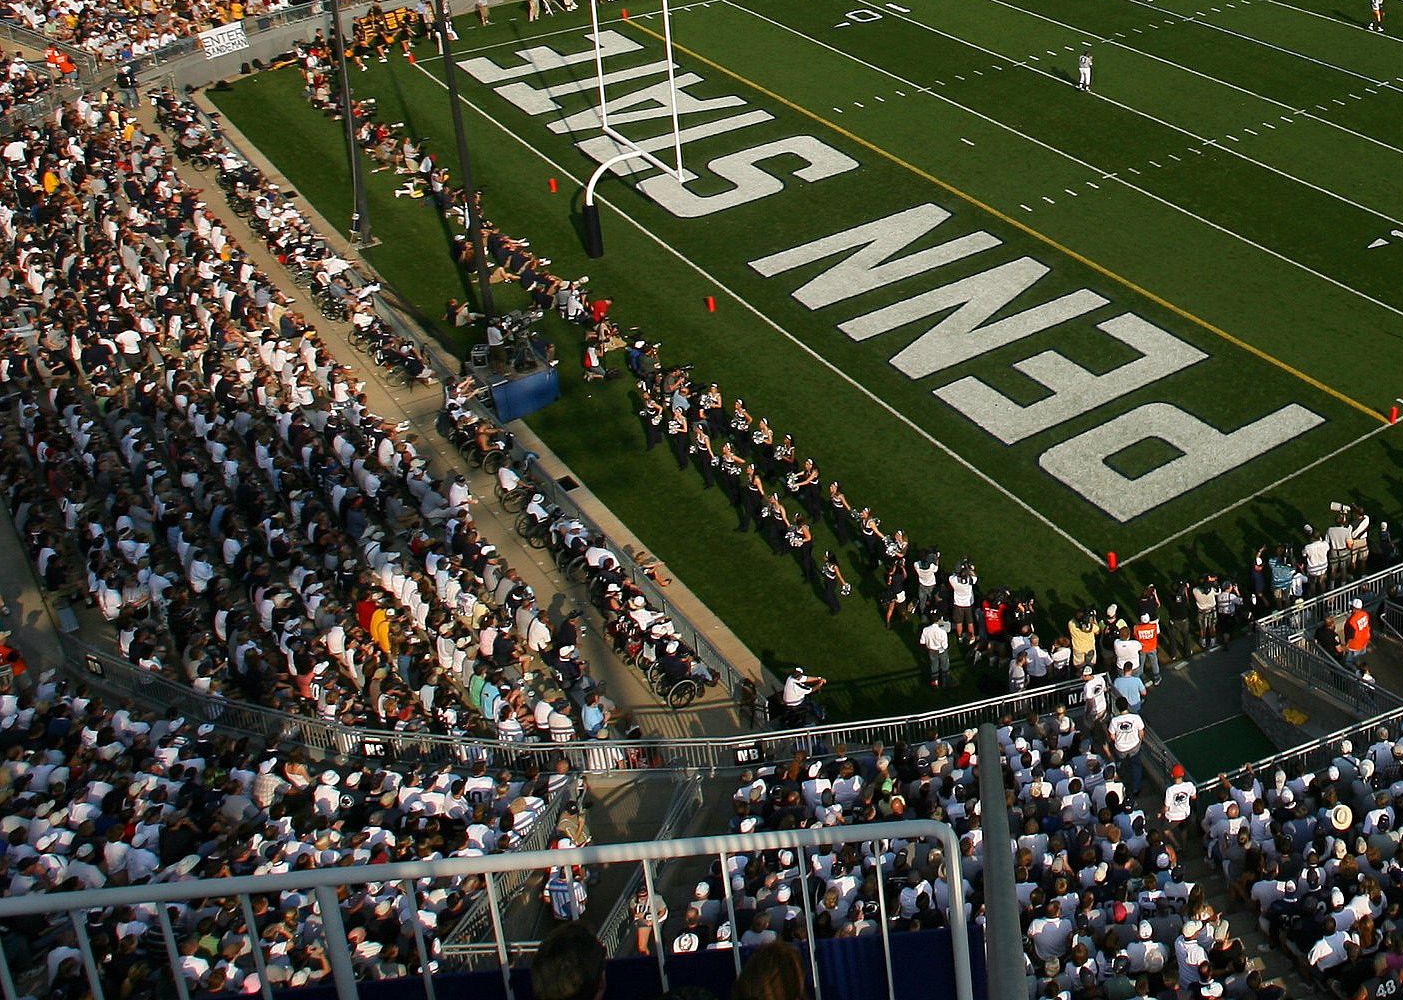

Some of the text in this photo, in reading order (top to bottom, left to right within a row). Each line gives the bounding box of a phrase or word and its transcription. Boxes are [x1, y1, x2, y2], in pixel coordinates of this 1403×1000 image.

[845, 1, 913, 24] 10
[202, 28, 245, 47] ENTER
[455, 29, 1328, 524] PENN STATE
[364, 743, 385, 757] NC
[736, 748, 759, 762] NB
[1375, 979, 1396, 998] 48
